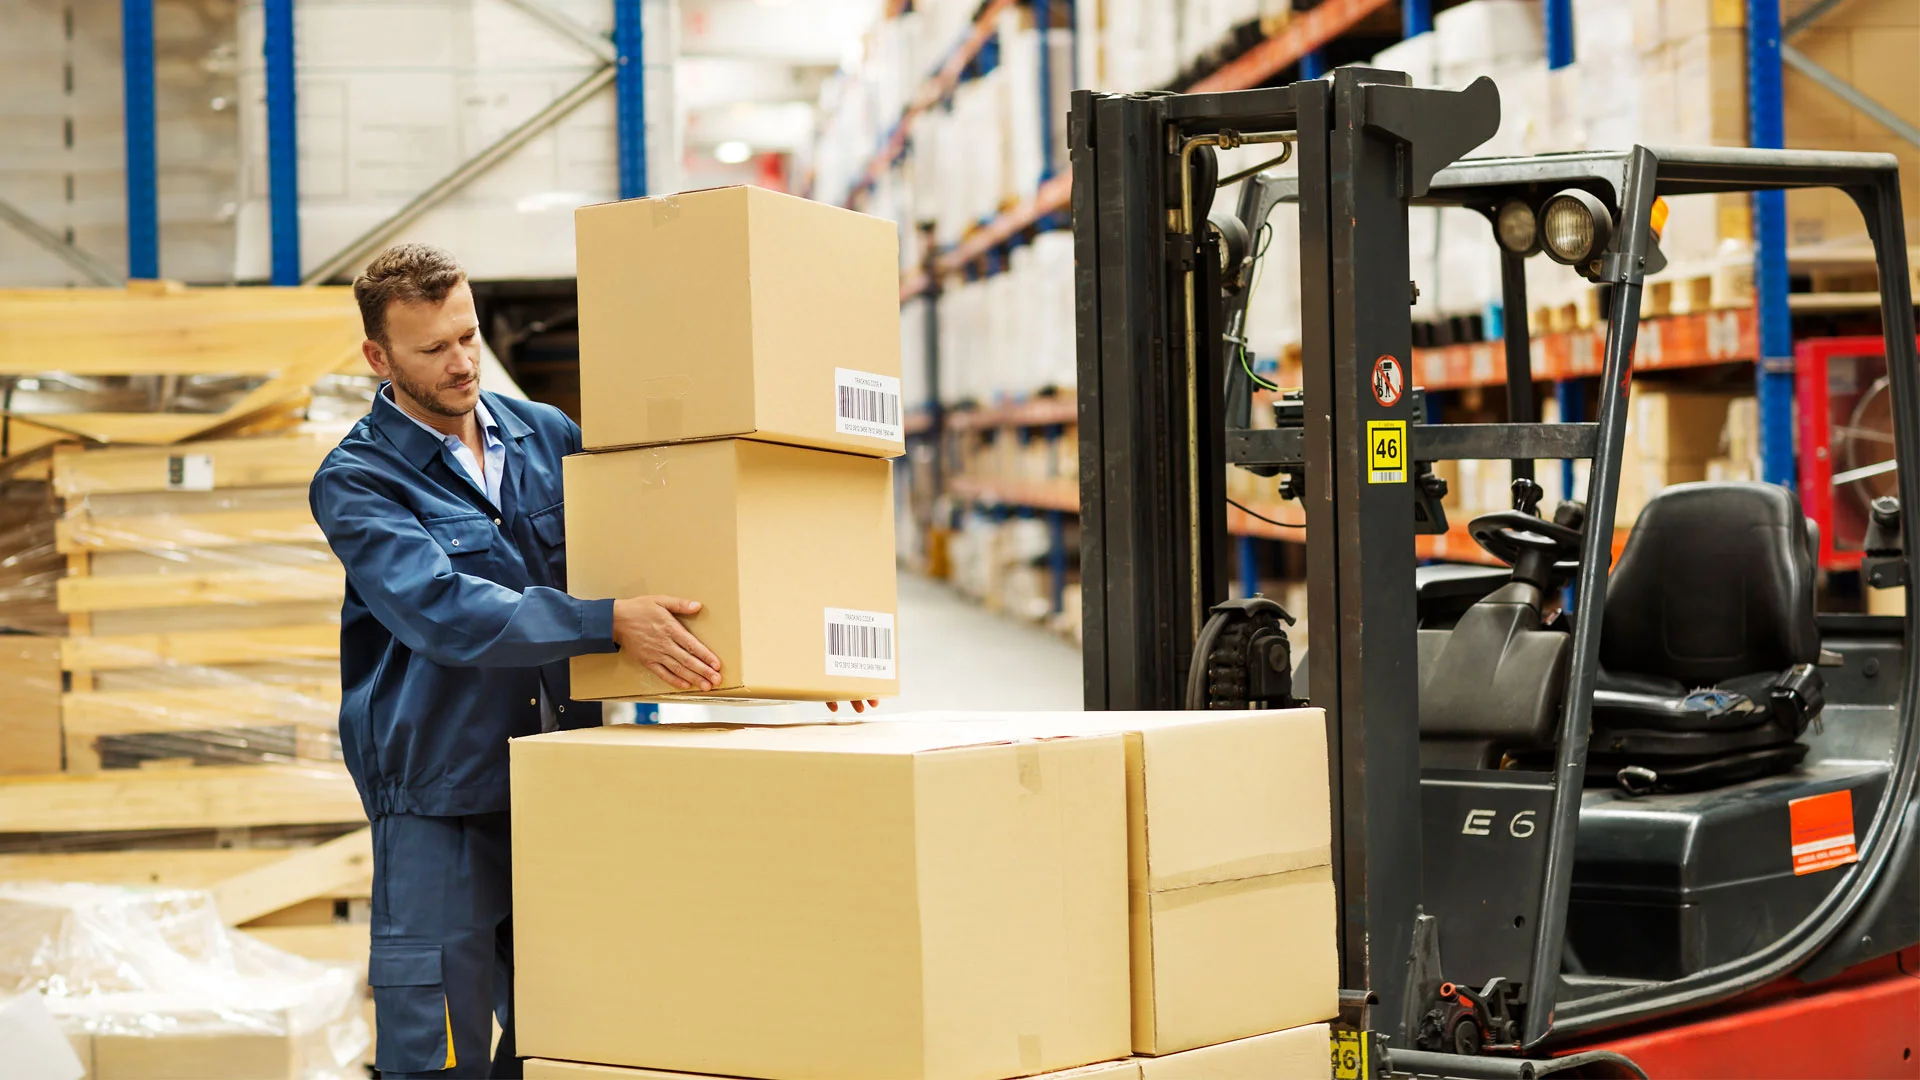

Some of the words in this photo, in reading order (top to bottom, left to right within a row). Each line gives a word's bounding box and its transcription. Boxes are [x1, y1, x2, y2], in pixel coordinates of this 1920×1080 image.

[1376, 438, 1397, 458] 46
[1461, 809, 1496, 835] E
[1509, 810, 1536, 838] 6
[1331, 1049, 1356, 1070] 46
